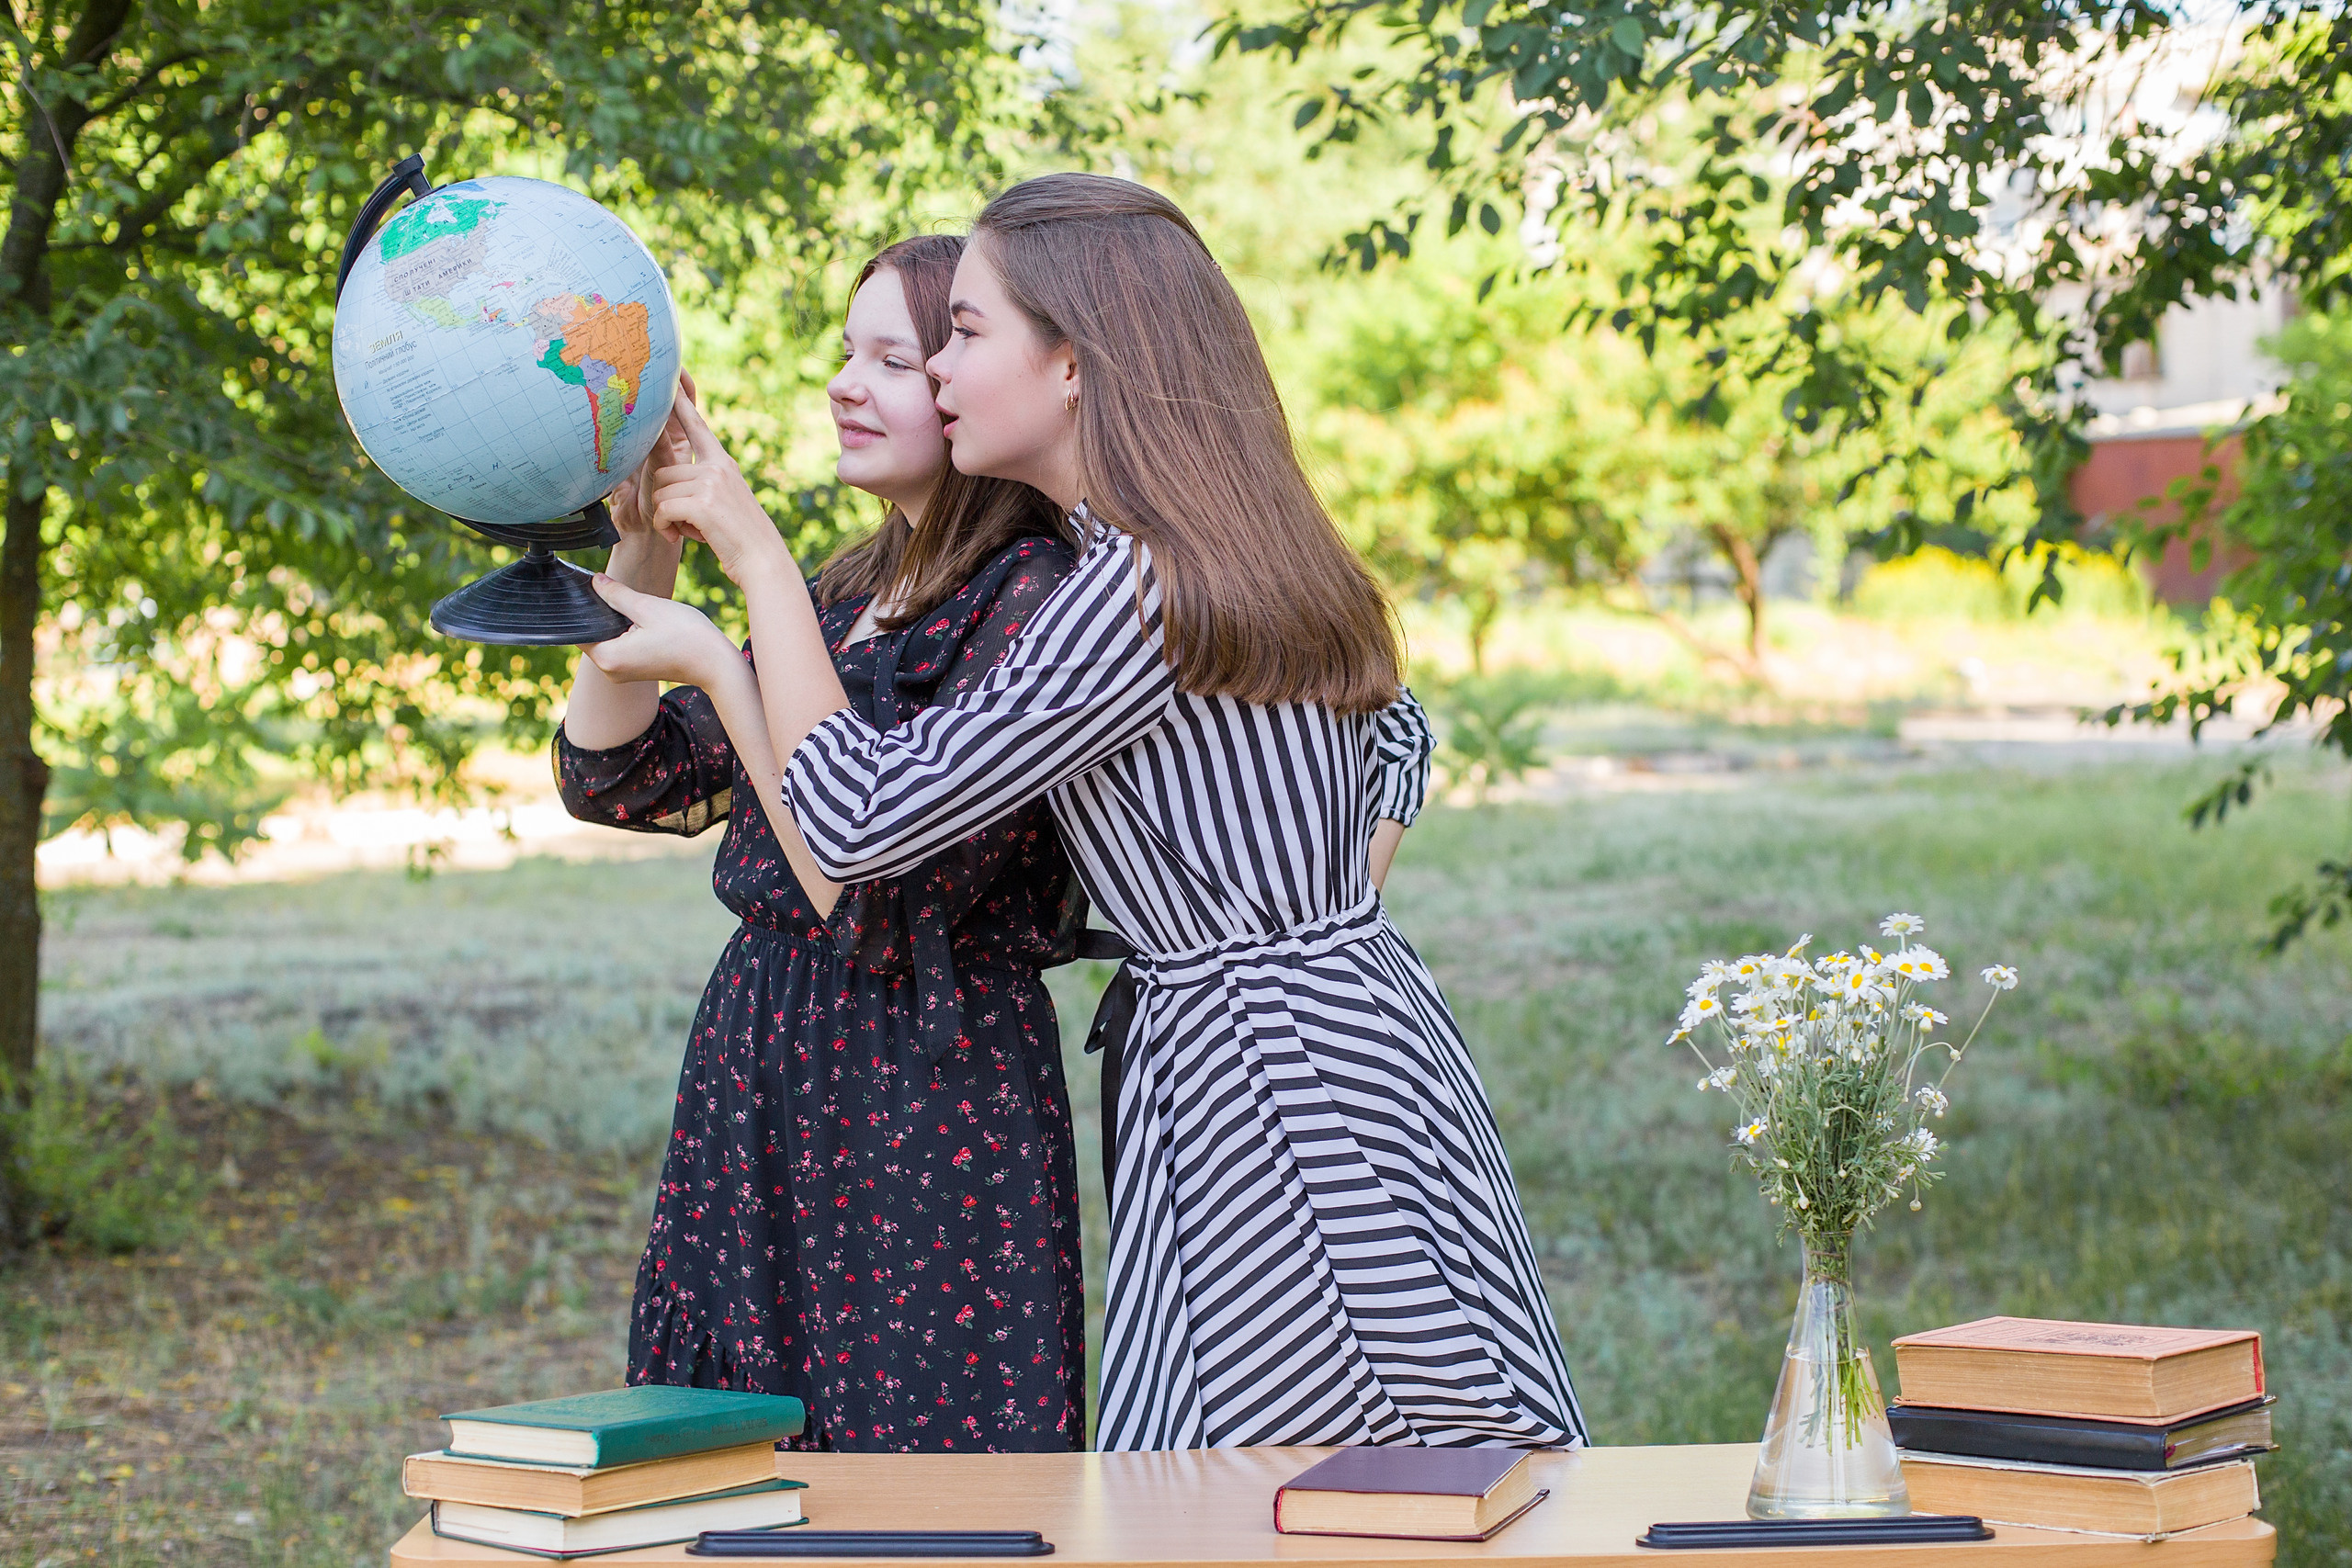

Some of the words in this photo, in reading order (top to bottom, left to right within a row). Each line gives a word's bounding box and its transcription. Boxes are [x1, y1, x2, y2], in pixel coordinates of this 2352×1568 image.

[393, 258, 436, 283] СПОЛУЧЕНІ
[438, 258, 472, 279] АМЕРИКИ
[369, 331, 403, 354] ЗЕМЛЯ
[395, 339, 418, 356] глобус
